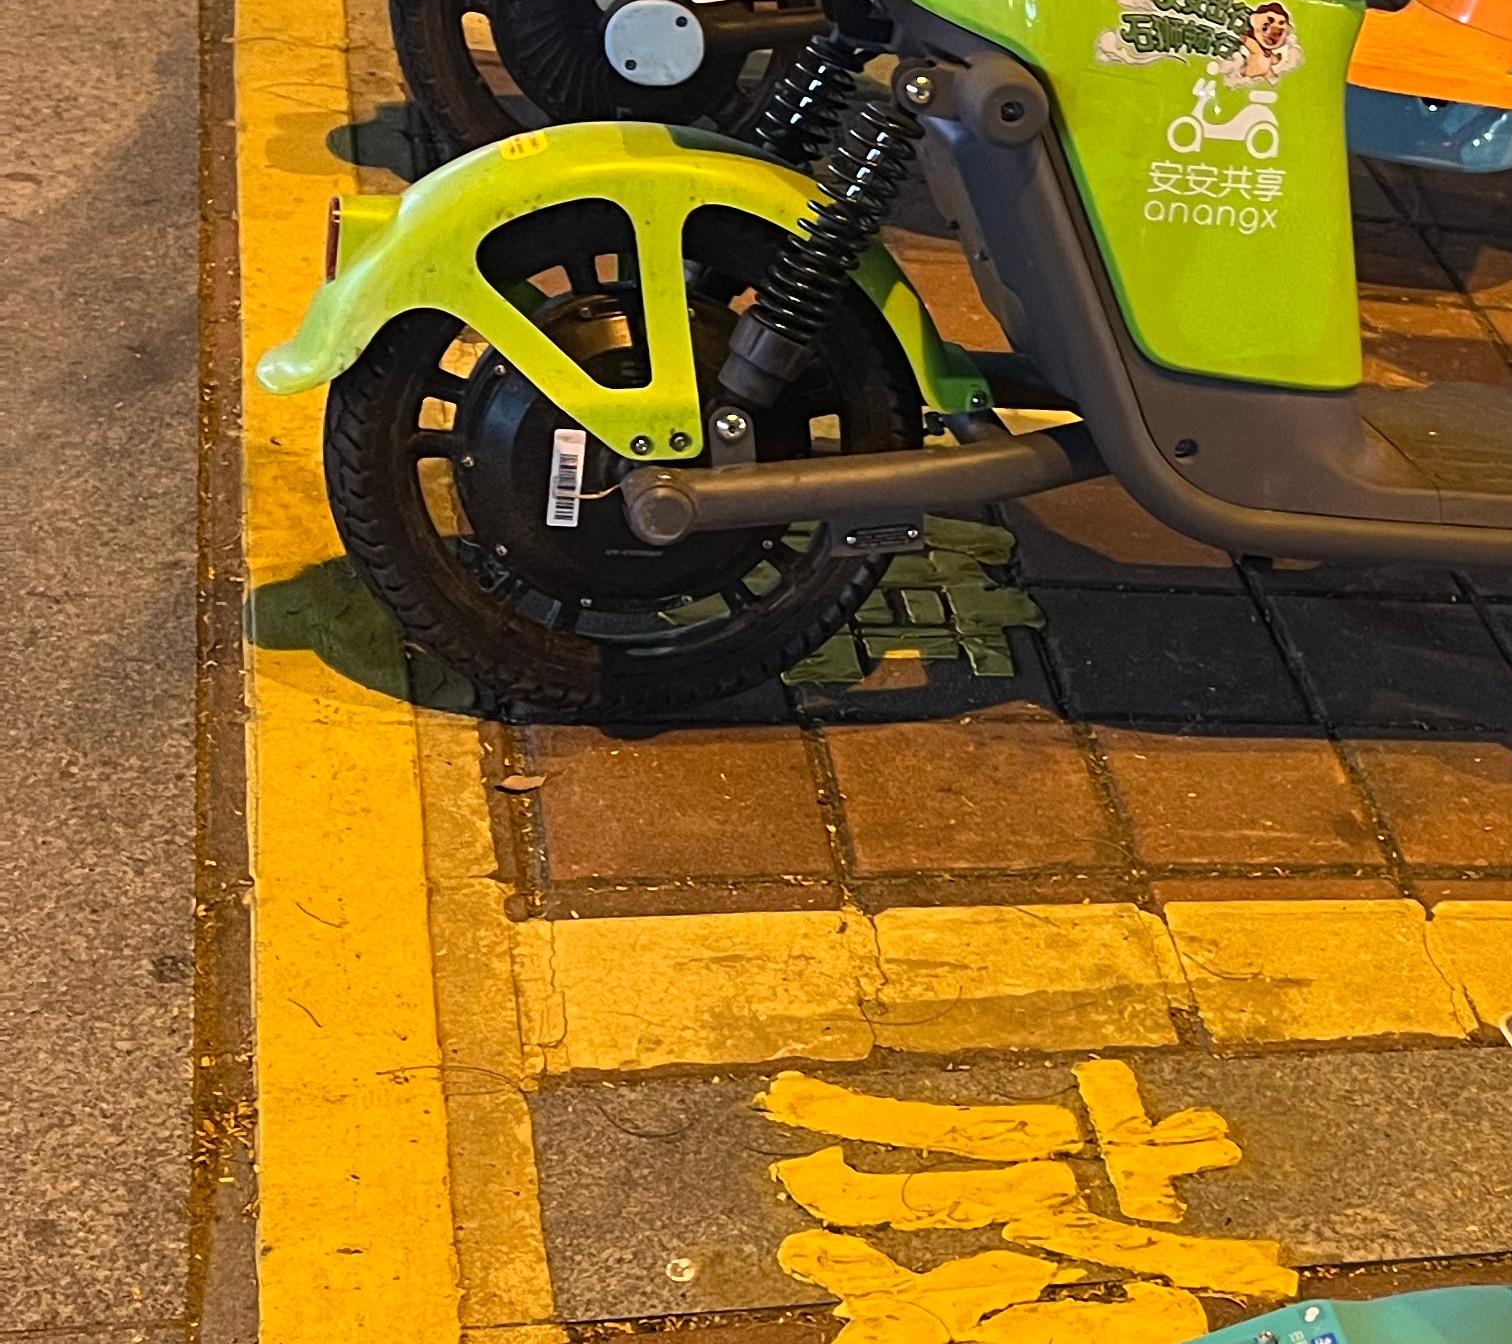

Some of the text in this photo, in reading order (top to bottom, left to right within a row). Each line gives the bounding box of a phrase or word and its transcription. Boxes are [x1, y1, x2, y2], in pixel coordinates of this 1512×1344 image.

[1147, 160, 1287, 202] 安安共享
[1144, 200, 1280, 234] anangx
